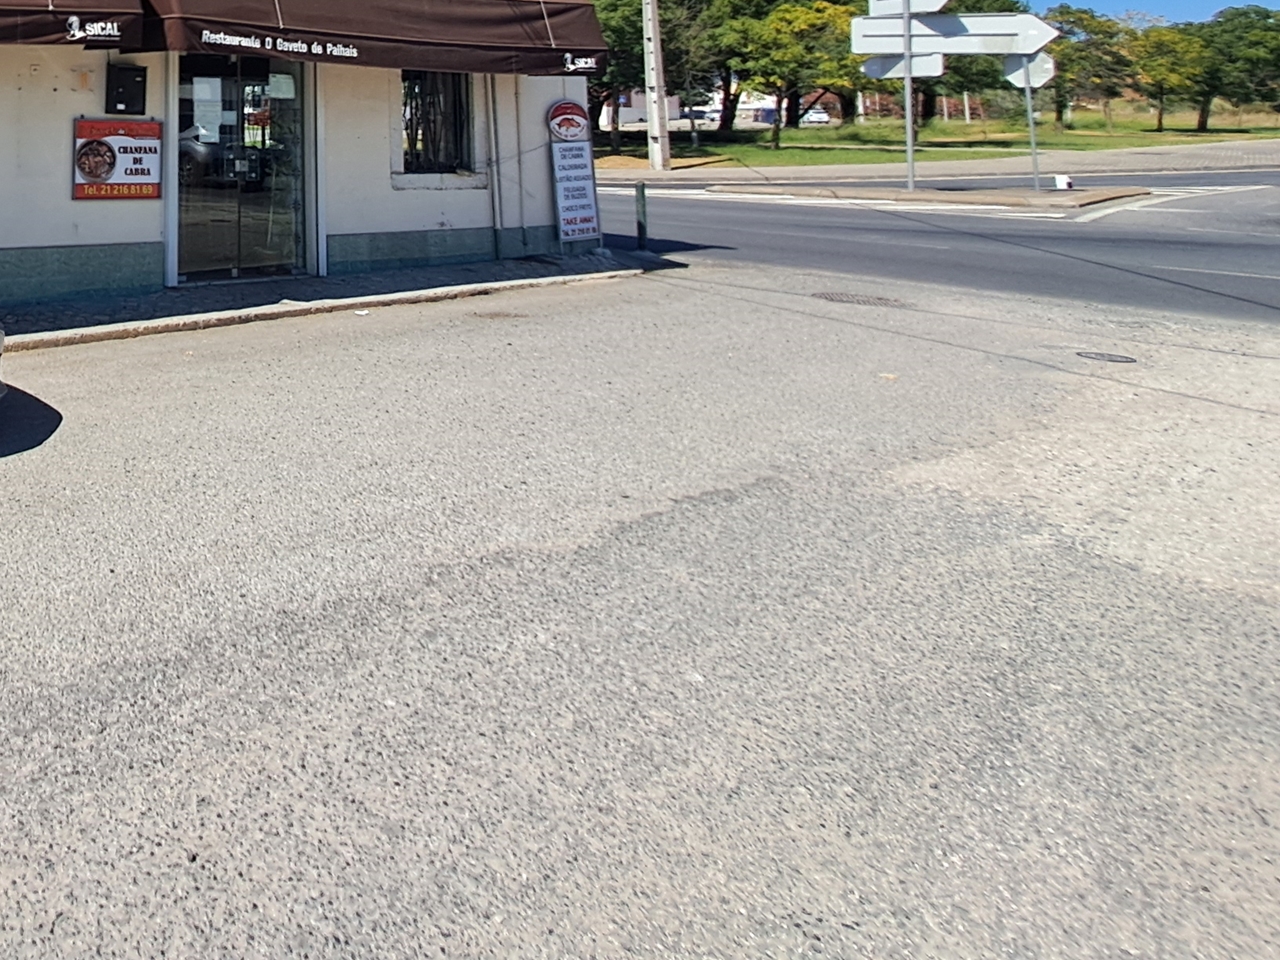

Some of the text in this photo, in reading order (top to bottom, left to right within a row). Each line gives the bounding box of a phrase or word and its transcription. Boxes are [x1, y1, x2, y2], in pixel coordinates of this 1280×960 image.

[85, 22, 121, 35] SICAL
[201, 29, 358, 57] Restaurante O Gaveto de Palhais
[132, 156, 143, 165] DE
[124, 167, 151, 176] CABRA
[84, 185, 153, 194] Tel. 21 216 81 69
